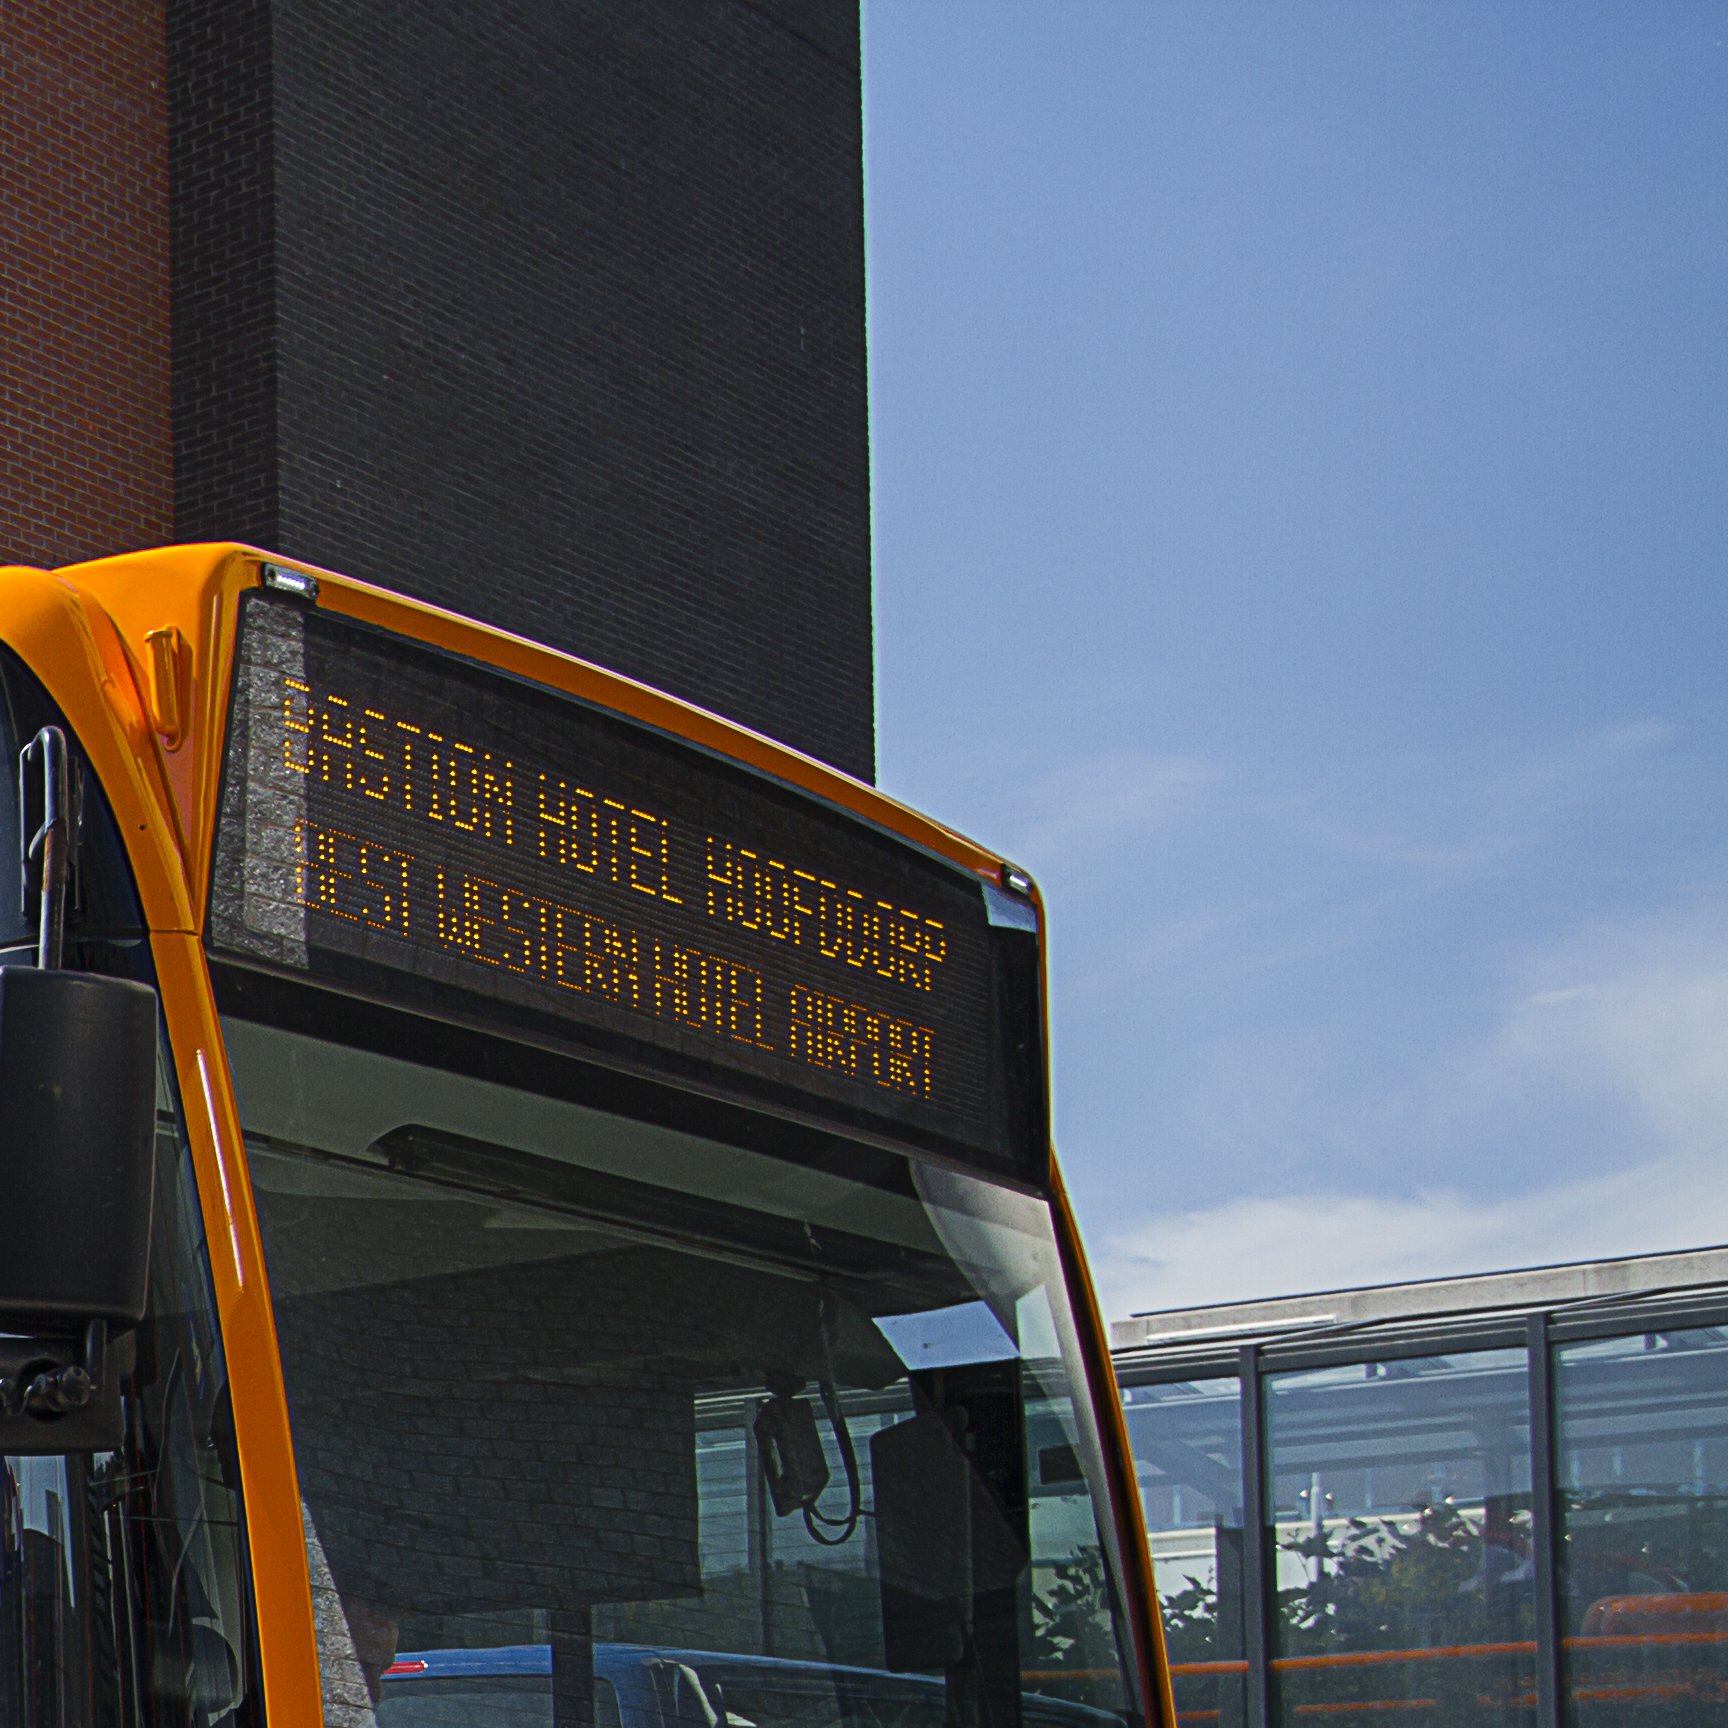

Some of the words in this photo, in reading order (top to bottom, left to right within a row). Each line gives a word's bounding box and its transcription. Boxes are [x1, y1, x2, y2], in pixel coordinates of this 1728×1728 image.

[282, 678, 514, 846] BASTION
[538, 772, 684, 905] HOTEL
[706, 835, 947, 992] HOOFDDORP
[295, 818, 416, 937] BEST
[437, 864, 639, 1009] WESTERN
[655, 936, 775, 1051] HOTEL
[790, 983, 936, 1099] AIRPORT
